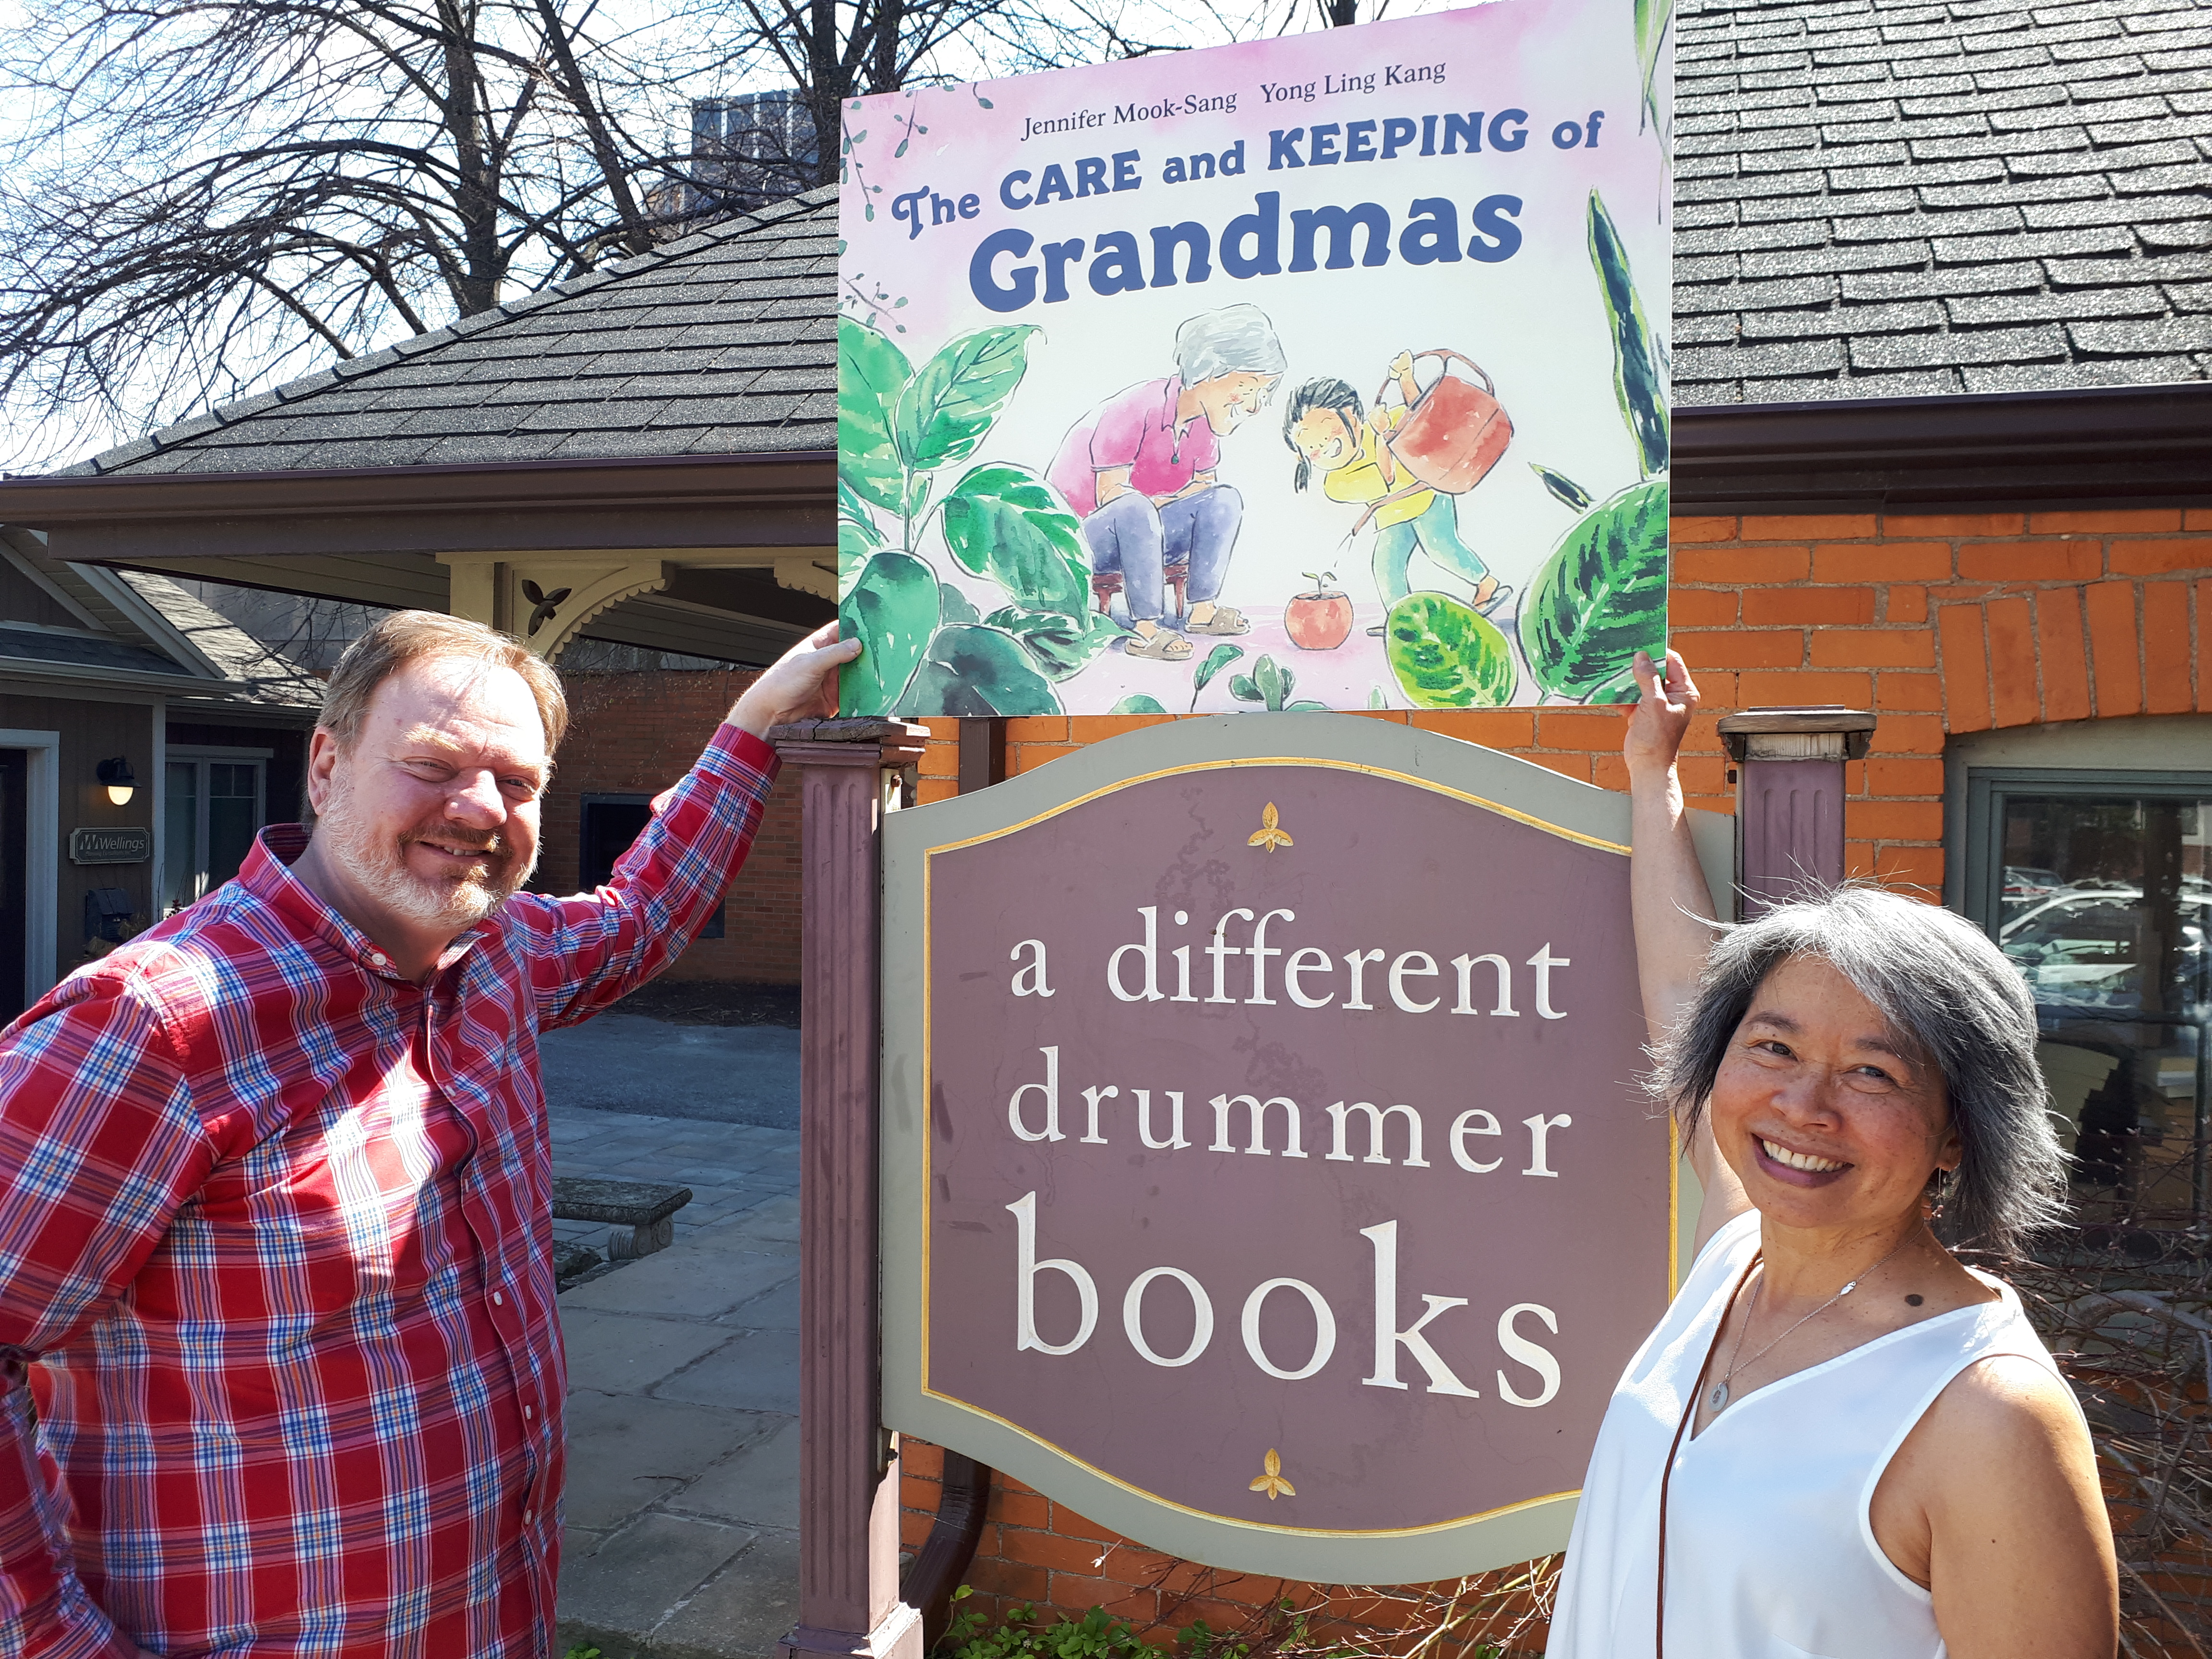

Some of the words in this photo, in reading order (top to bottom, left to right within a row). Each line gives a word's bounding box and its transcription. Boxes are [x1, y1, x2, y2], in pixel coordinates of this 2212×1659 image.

[1020, 108, 1106, 141] Jennifer
[1113, 91, 1238, 125] Mook-Sang
[1260, 82, 1316, 104] Yong
[1324, 73, 1376, 95] Ling
[1384, 60, 1446, 86] Kang
[891, 185, 981, 240] The
[999, 149, 1142, 211] CARE
[1162, 140, 1246, 184] and
[1267, 108, 1529, 171] KEEPING
[1551, 110, 1605, 150] of
[968, 190, 1524, 313] Grandmas
[98, 836, 144, 853] Wellings
[1010, 938, 1056, 998] a
[1106, 905, 1571, 1020] different
[1008, 1045, 1573, 1178] drummer
[1005, 1190, 1562, 1408] books
